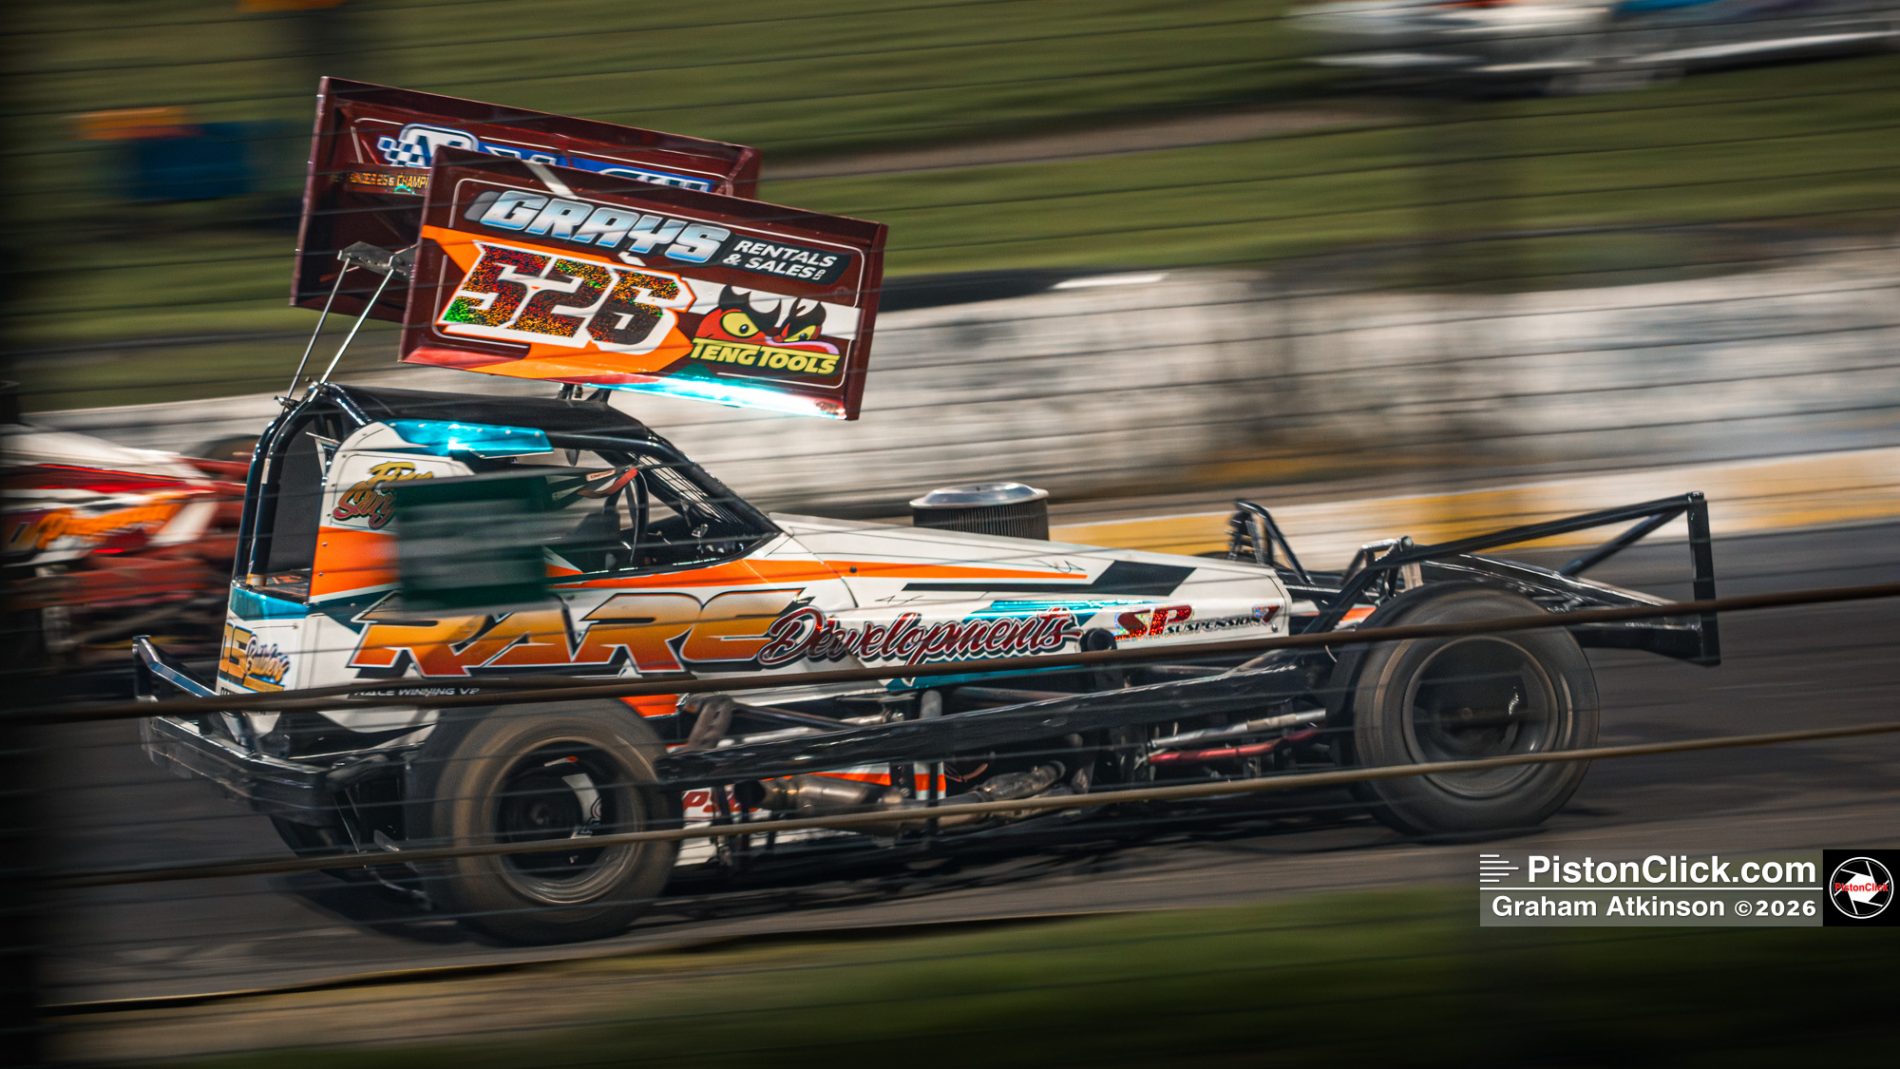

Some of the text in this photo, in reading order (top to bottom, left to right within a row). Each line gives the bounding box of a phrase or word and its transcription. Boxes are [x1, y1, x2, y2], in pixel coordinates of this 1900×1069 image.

[480, 190, 730, 264] GRAYS
[734, 240, 837, 267] RENTALS
[723, 253, 741, 265] &
[745, 257, 816, 278] SALES
[441, 241, 688, 355] 526
[691, 338, 840, 375] TENG TOOLS
[346, 587, 806, 677] RARE
[757, 605, 1083, 686] Developments
[1115, 604, 1193, 641] SP
